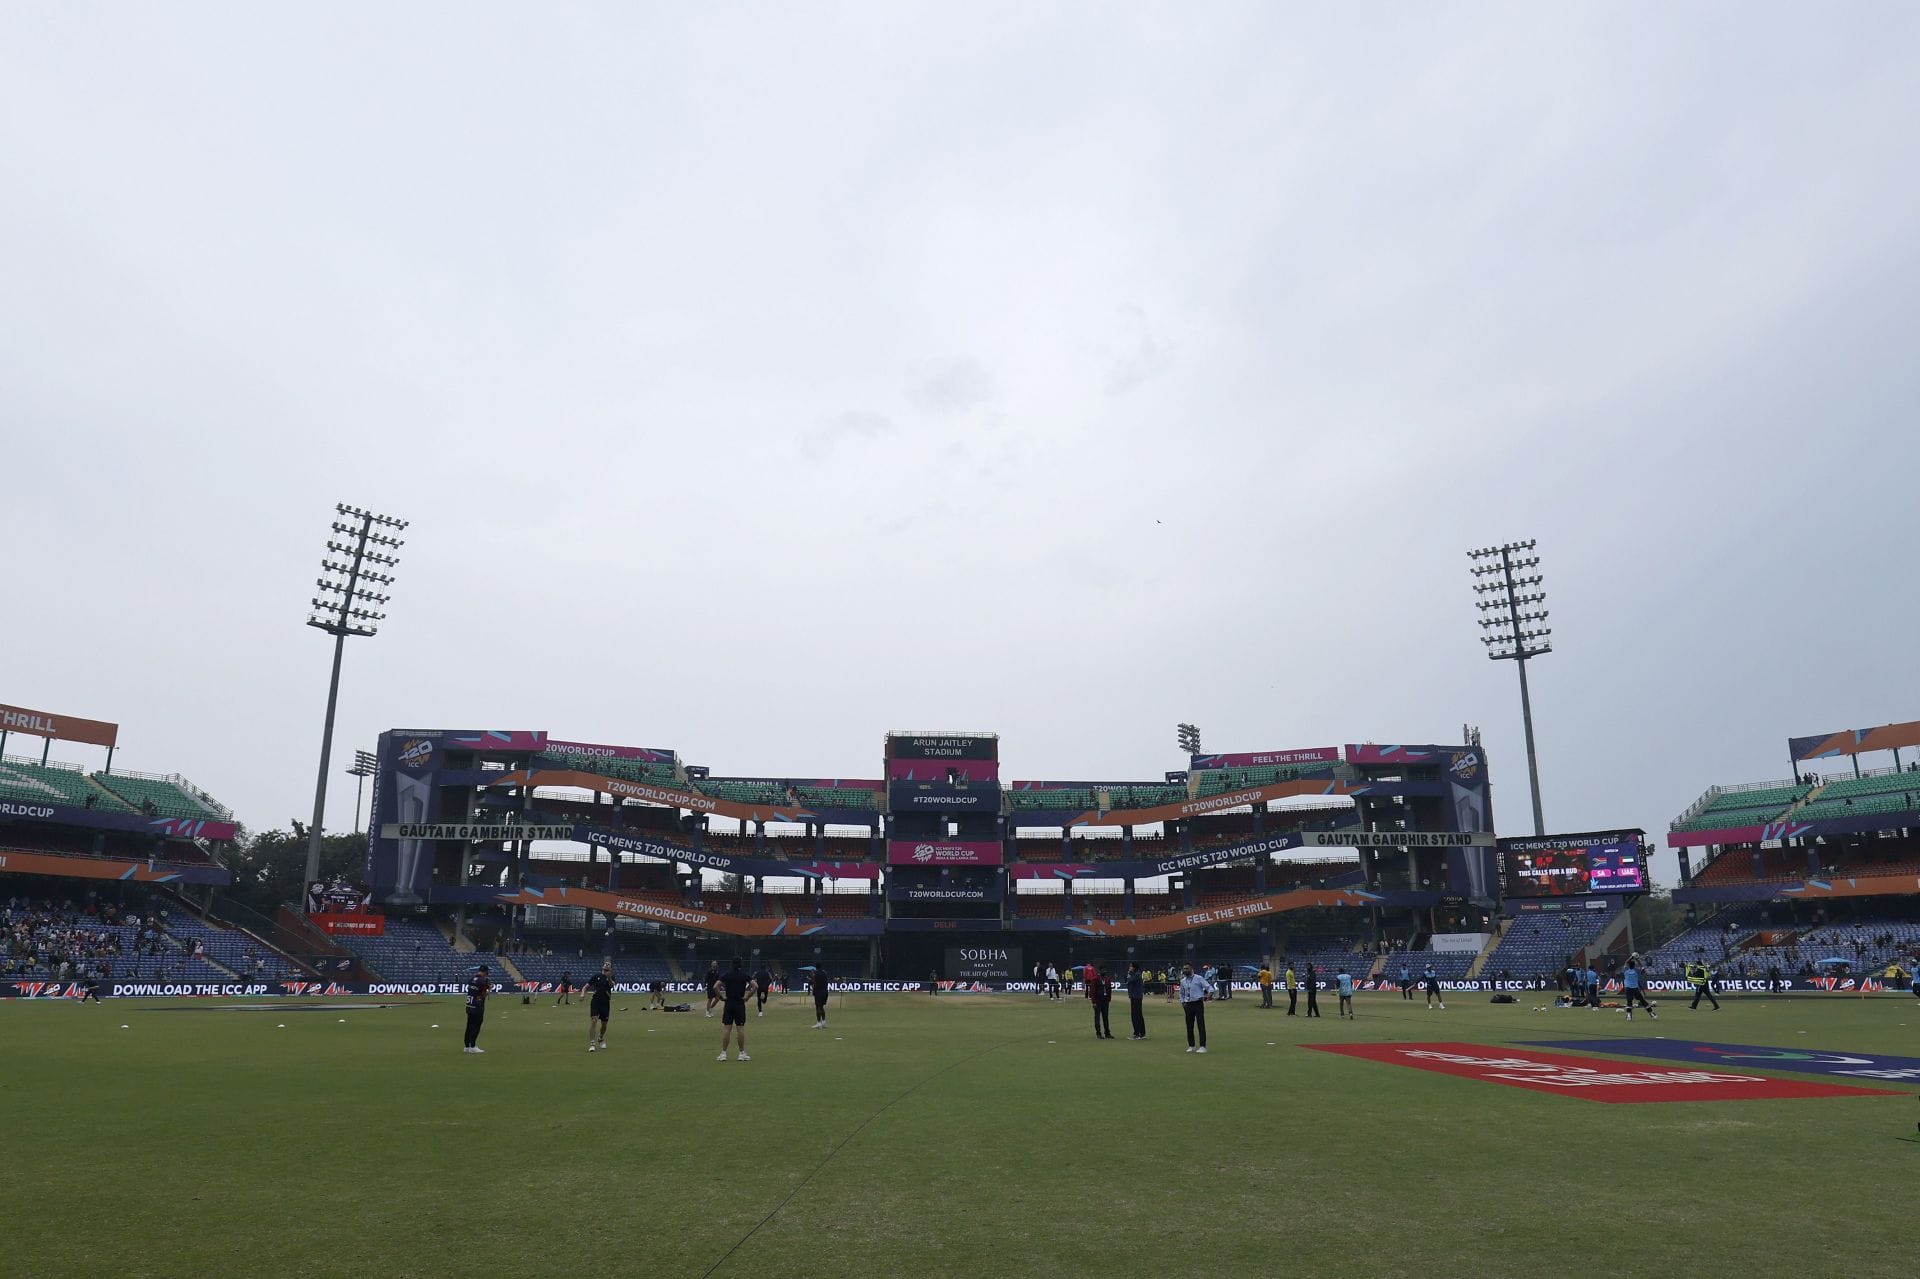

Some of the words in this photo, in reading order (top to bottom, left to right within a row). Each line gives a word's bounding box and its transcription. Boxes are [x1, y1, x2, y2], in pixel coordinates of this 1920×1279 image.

[939, 739, 973, 747] JAITLEY
[545, 743, 615, 757] 20WORLDCUP
[1274, 754, 1291, 762] THE
[1293, 752, 1323, 761] THRILL
[606, 781, 716, 810] T20WORLDCUP.COM
[913, 796, 978, 804] #T20WORLDCUP
[1182, 791, 1262, 813] #T20WORLDCUP
[0, 803, 55, 818] RLDCUP
[400, 825, 456, 839] GAUTAM
[459, 826, 523, 839] GAMBHIR
[527, 826, 573, 839] STAND
[1317, 834, 1369, 845] GAUTAM
[1372, 834, 1428, 845] GAMBHIR
[1431, 834, 1472, 845] STAND
[1569, 839, 1600, 847] WORLD
[1602, 837, 1619, 845] CUP
[587, 831, 606, 844] ICC
[608, 835, 643, 851] MEN'S
[644, 843, 664, 855] T20
[666, 847, 706, 863] WORLD
[708, 856, 731, 868] CUP
[1157, 861, 1176, 872] ICC
[1177, 854, 1209, 869] MEN'S
[1210, 850, 1228, 862] T20
[1229, 842, 1266, 857] WORLD
[1268, 838, 1289, 849] CUP
[1549, 868, 1561, 876] FOR
[616, 900, 708, 924] #T20WORLDCUP
[1186, 913, 1211, 925] FEEL
[1214, 909, 1234, 920] THE
[1236, 901, 1273, 915] THRILL
[960, 948, 1008, 960] SOBHA
[113, 984, 192, 995] DOWNLOAD
[195, 984, 219, 995] THE
[221, 984, 243, 995] ICC
[244, 984, 268, 995] APP
[368, 983, 436, 994] DOWNLOAD
[438, 983, 460, 993] THE
[677, 982, 694, 991] ICC
[803, 982, 860, 991] DNLOAD
[862, 982, 882, 991] THE
[883, 982, 900, 991] ICC
[901, 982, 921, 991] APP
[1505, 981, 1523, 989] ICC
[1719, 980, 1743, 990] THE
[1746, 980, 1766, 989] ICC
